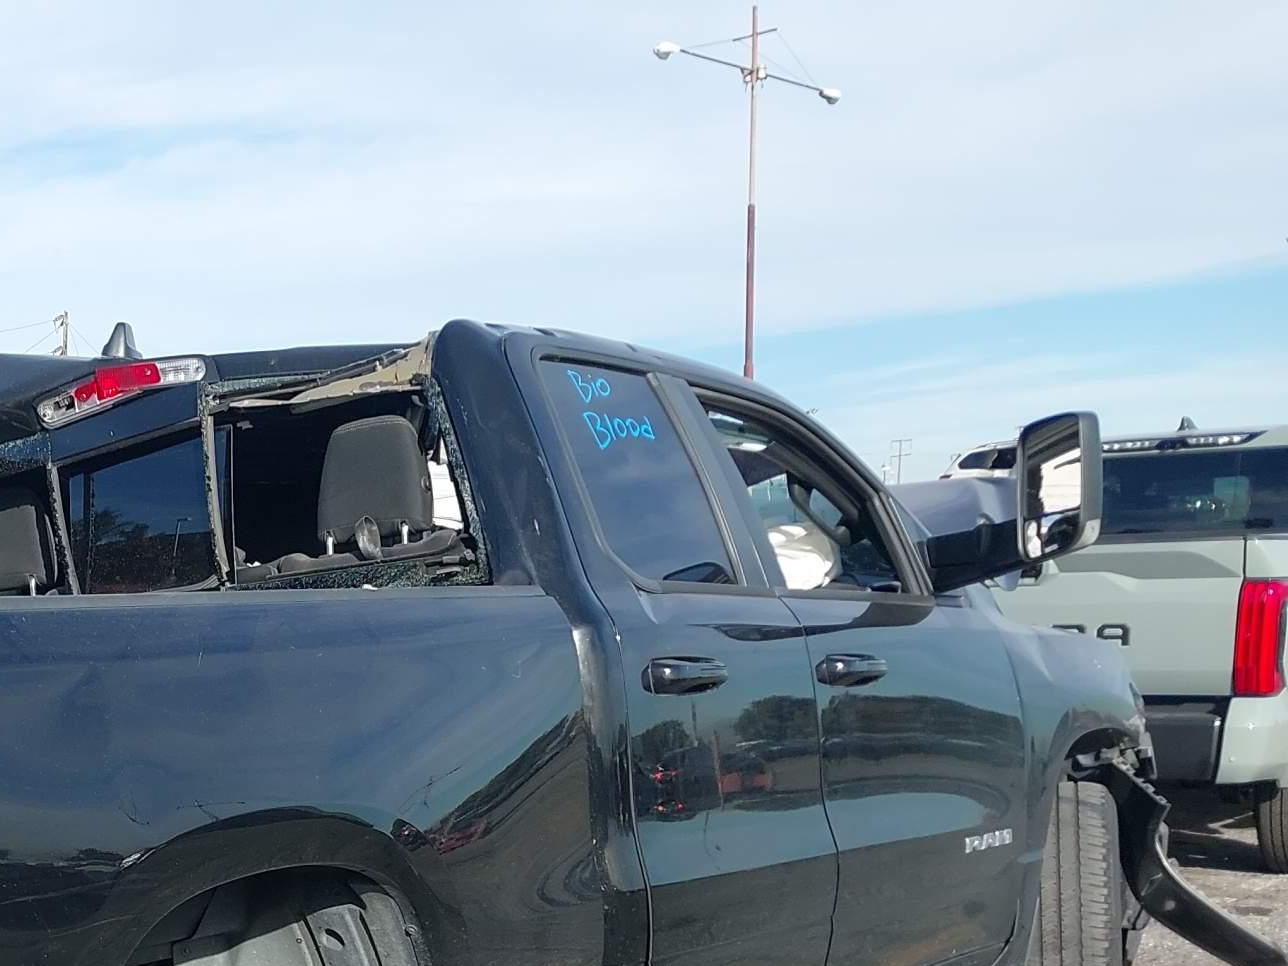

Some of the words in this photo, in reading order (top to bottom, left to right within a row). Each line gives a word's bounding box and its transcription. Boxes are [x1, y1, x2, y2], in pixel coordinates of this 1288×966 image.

[567, 369, 611, 403] Bio
[583, 411, 656, 449] Blood
[965, 828, 1013, 853] RAM
